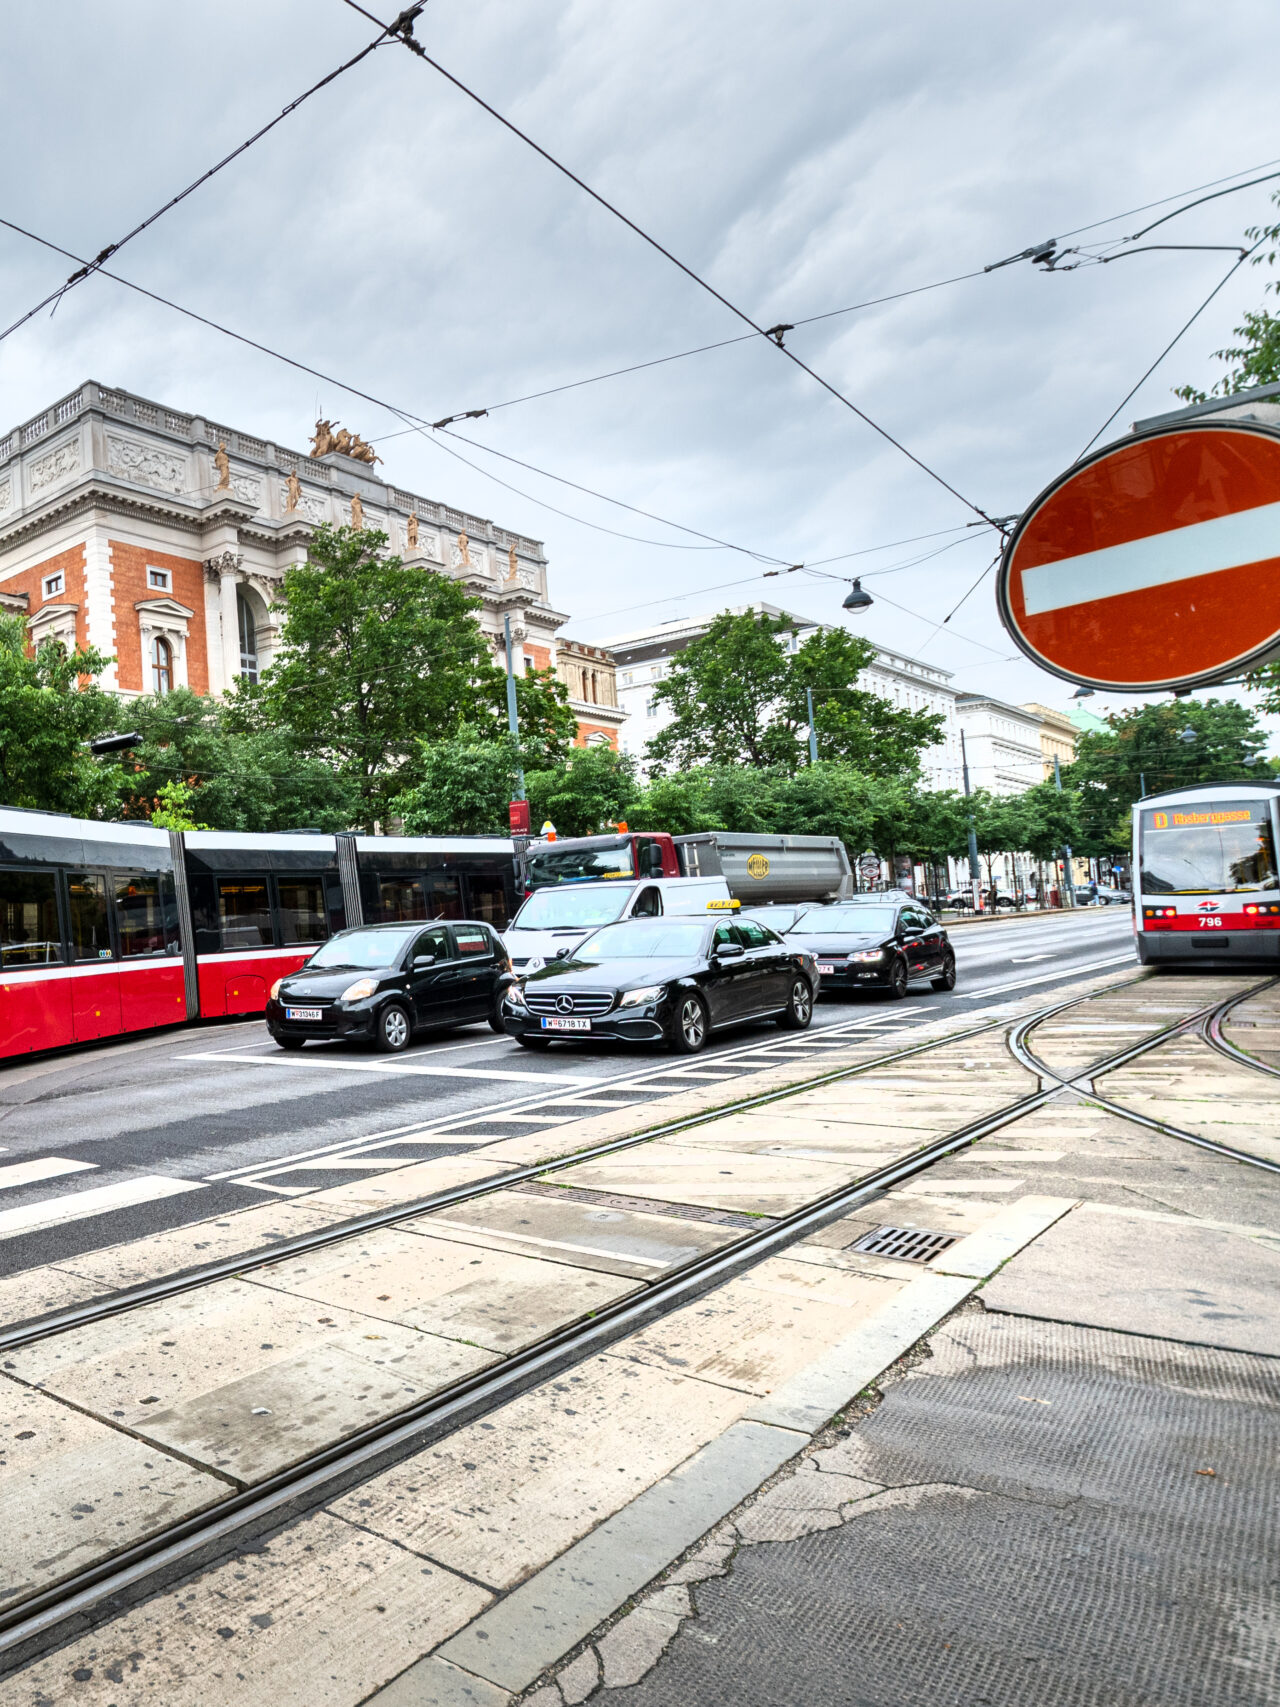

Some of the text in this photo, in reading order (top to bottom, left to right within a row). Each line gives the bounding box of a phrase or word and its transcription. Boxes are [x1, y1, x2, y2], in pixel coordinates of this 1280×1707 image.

[1153, 812, 1168, 829] D
[1198, 917, 1222, 927] 796
[557, 1020, 575, 1028] 6718
[577, 1020, 587, 1028] TX
